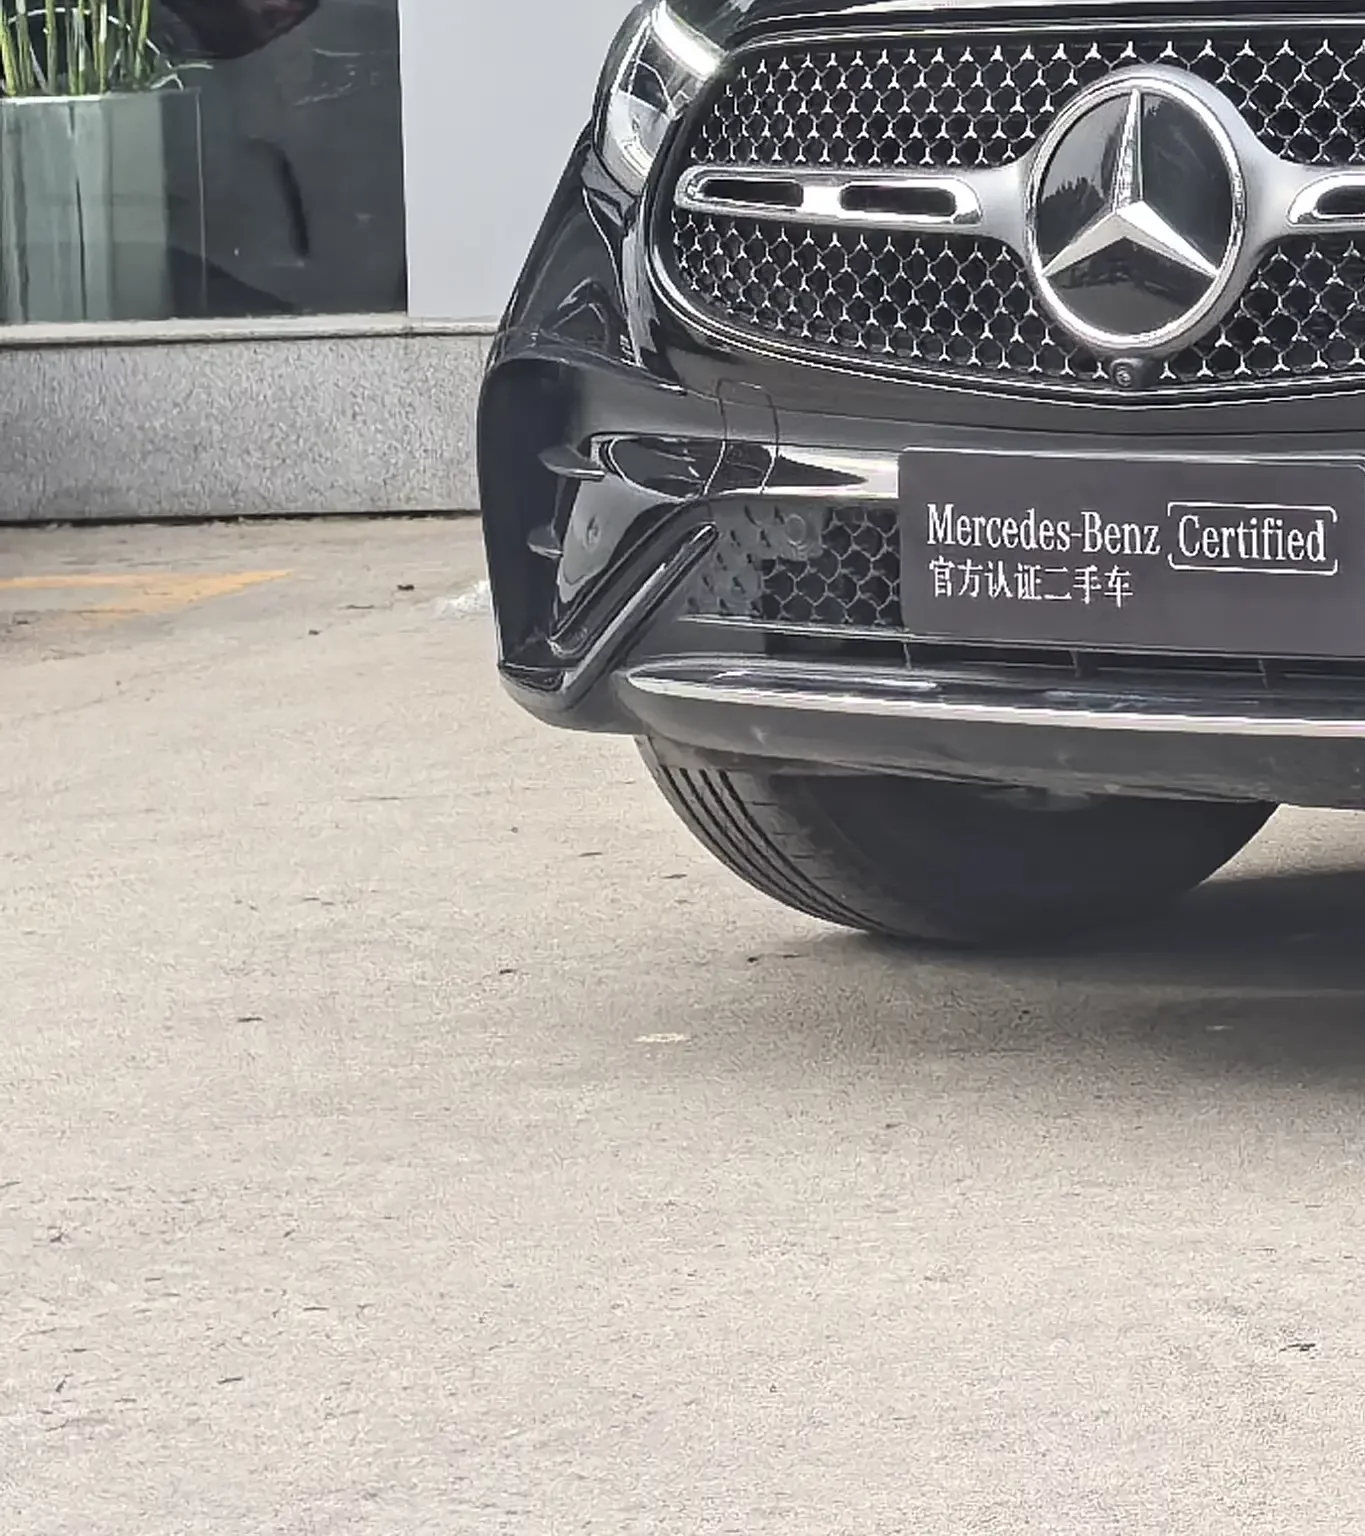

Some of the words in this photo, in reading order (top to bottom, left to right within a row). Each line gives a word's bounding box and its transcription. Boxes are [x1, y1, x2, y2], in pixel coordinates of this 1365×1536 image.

[926, 504, 1160, 557] Mercedes-Benz
[1178, 514, 1325, 561] Certified
[928, 556, 1133, 607] 官方认证二手车
